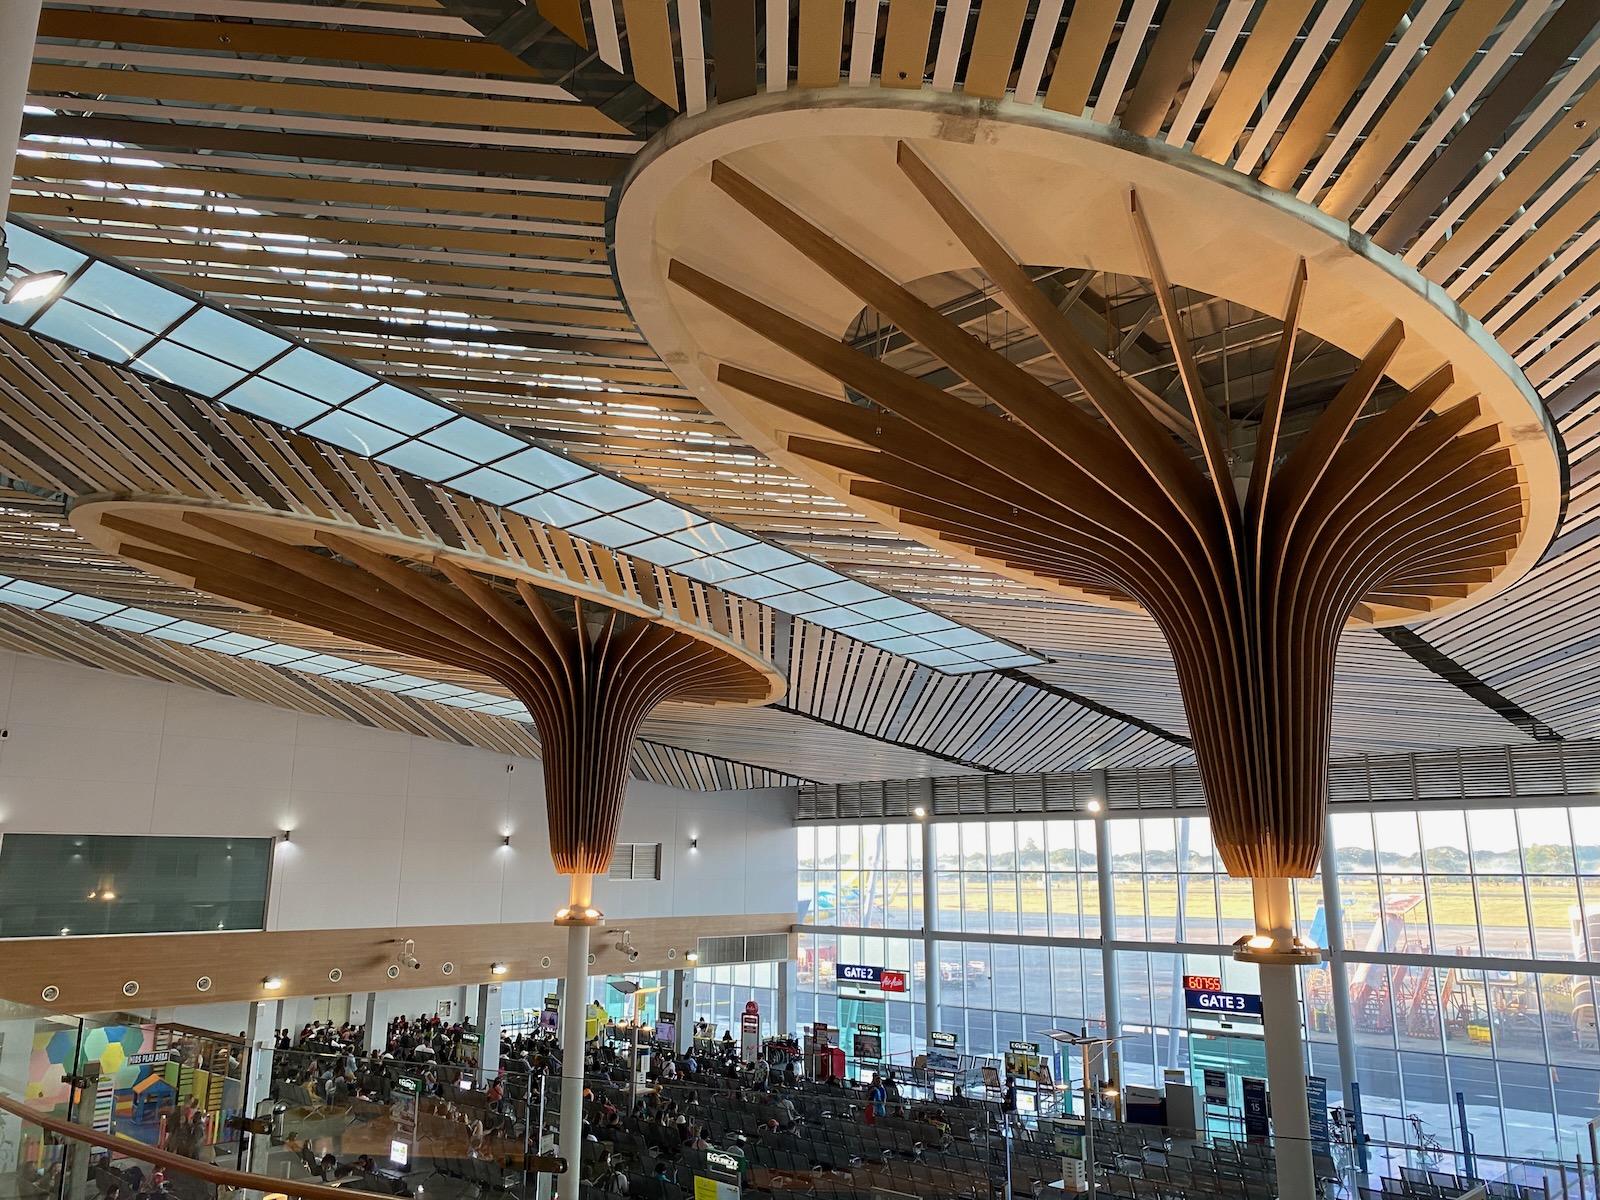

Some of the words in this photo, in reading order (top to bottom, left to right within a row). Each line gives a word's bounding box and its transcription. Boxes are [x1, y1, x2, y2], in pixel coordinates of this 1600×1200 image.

[844, 966, 866, 979] GATE
[867, 968, 874, 979] 2
[1199, 994, 1235, 1008] GATE
[1236, 997, 1246, 1009] 3
[142, 1054, 154, 1062] PLAY
[154, 1052, 168, 1061] AREA
[1250, 1102, 1261, 1112] 15
